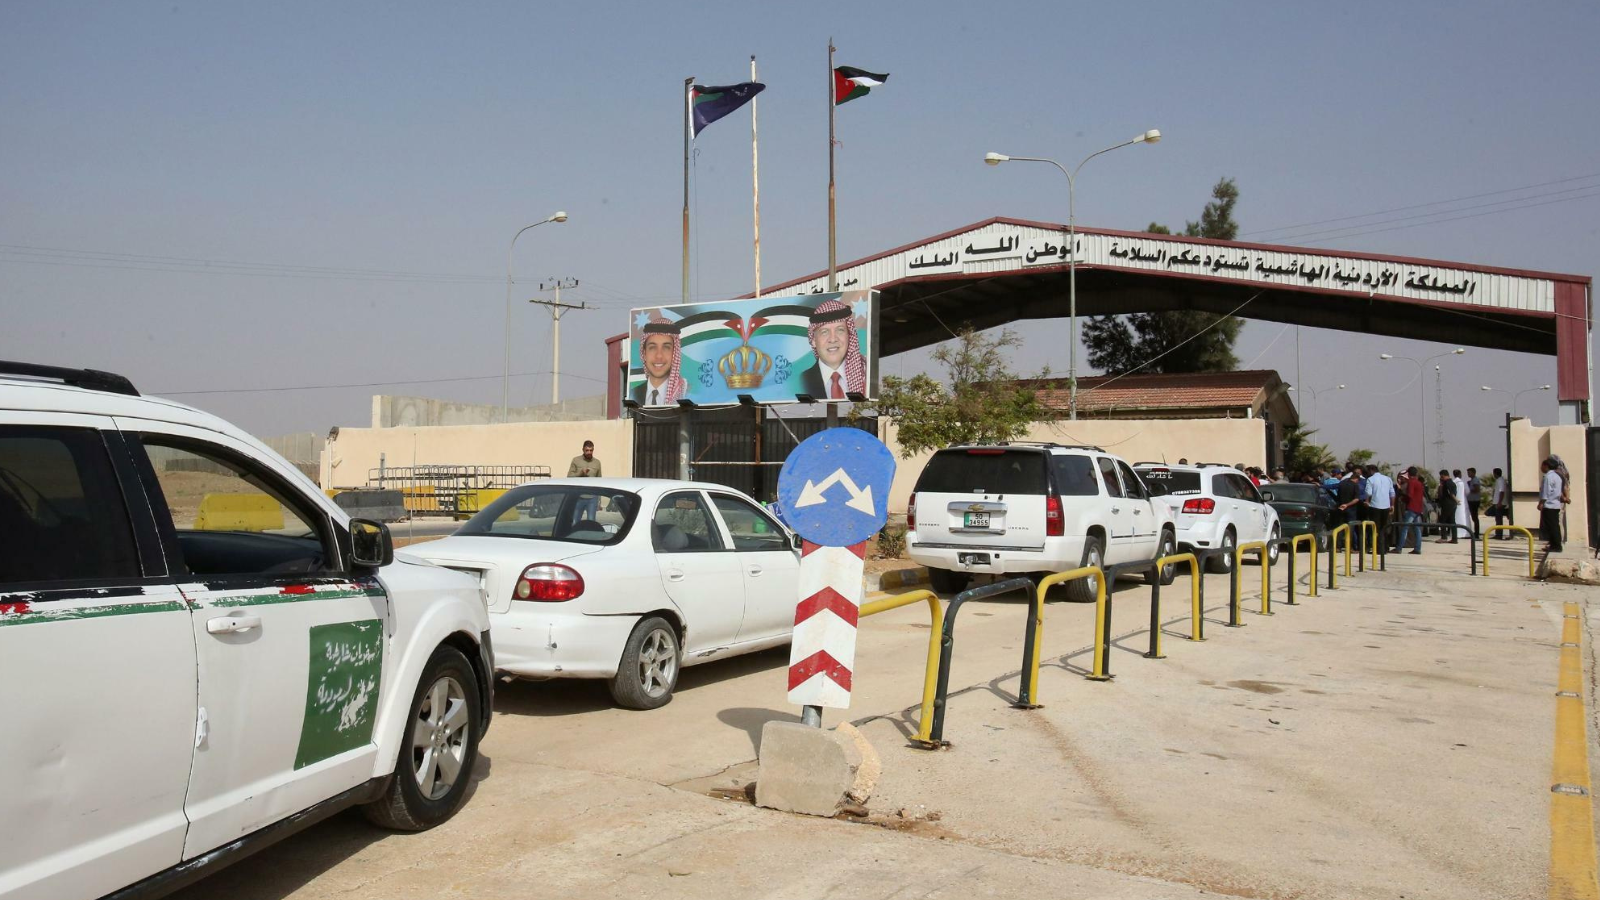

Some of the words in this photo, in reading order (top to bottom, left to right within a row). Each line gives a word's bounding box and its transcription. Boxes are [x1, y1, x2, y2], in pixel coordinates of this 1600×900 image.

[965, 234, 1020, 255] الله
[1109, 242, 1167, 264] السلامة
[908, 251, 959, 270] الملك
[1167, 249, 1250, 273] تستودعكم
[1255, 257, 1331, 283] الهاشمية
[1332, 262, 1399, 288] الأردنية
[1404, 271, 1476, 297] المملكة
